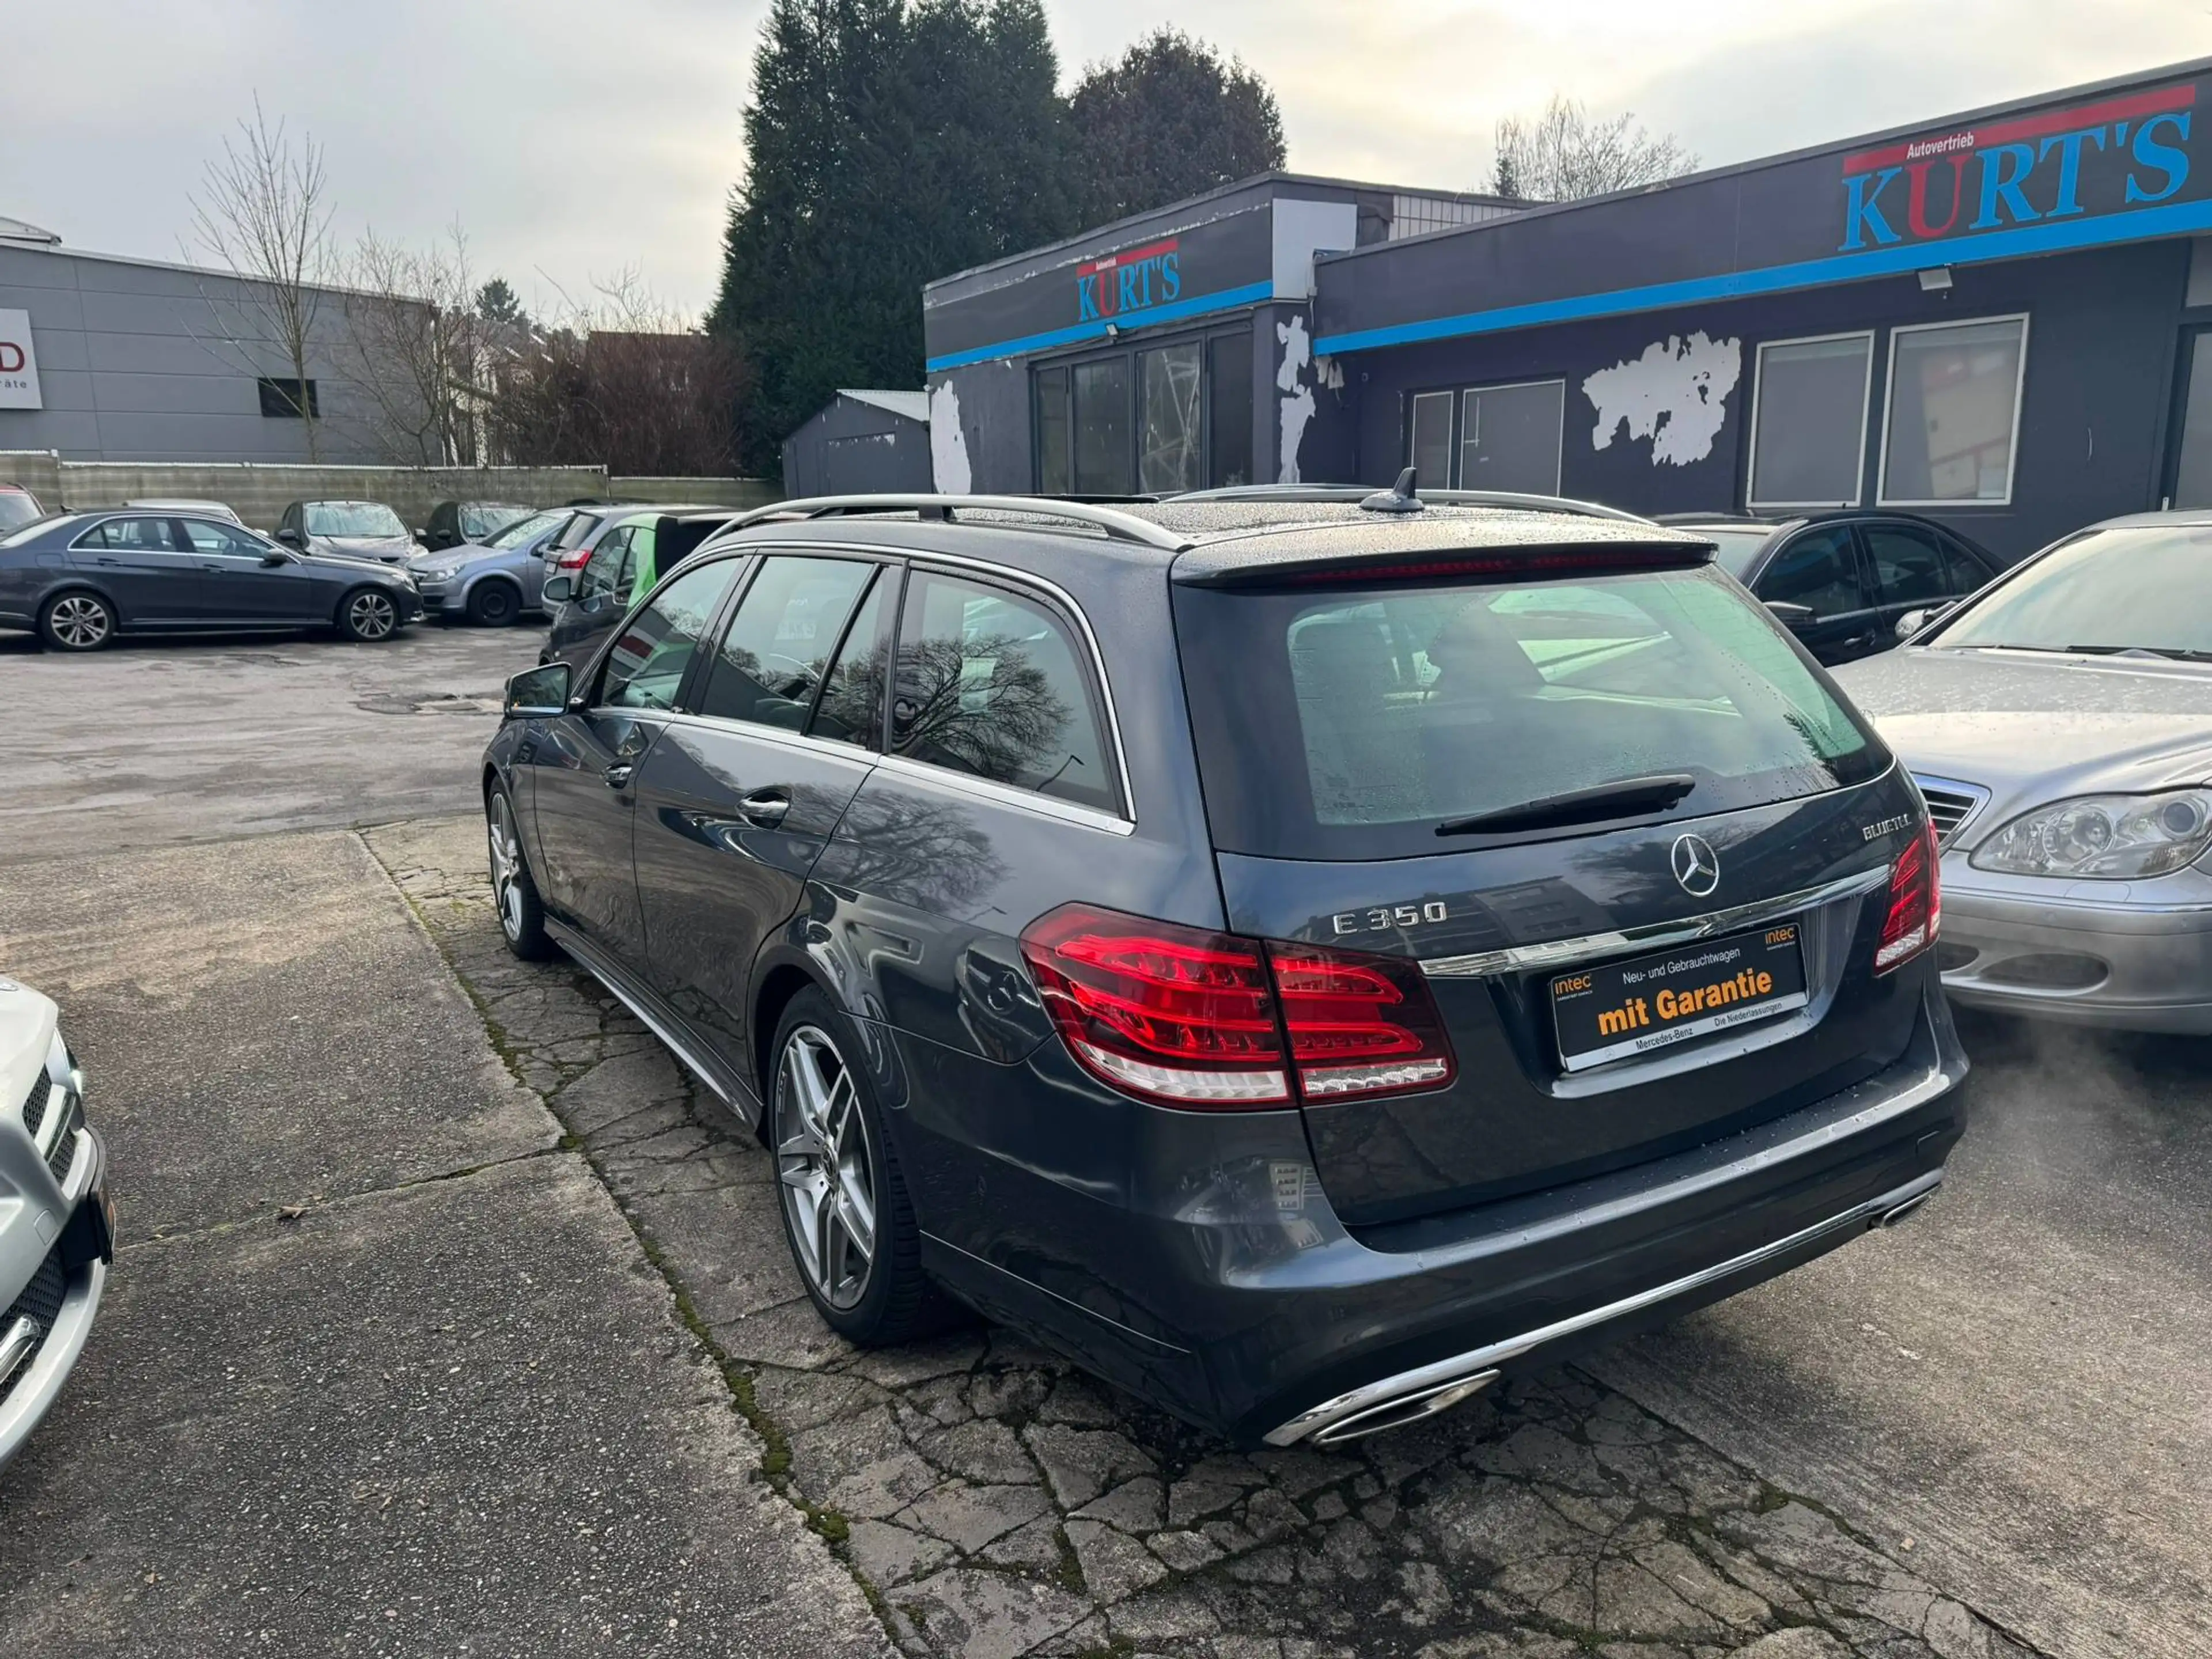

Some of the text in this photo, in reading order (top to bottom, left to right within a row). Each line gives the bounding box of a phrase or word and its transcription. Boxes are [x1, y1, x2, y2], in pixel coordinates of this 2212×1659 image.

[1906, 131, 1975, 160] Autovertrieb
[1838, 111, 2192, 252] KURT'S
[1077, 251, 1180, 322] KURT'S
[0, 379, 26, 389] äte
[1332, 901, 1448, 935] E 350
[1764, 927, 1795, 945] intec
[1622, 948, 1741, 985] Neu- und Gebrauchtwagen
[1555, 975, 1592, 995] intec
[1598, 967, 1772, 1035] mit Garantie
[1636, 1002, 1783, 1050] Mercedes-Benz Die Niederlassungen
